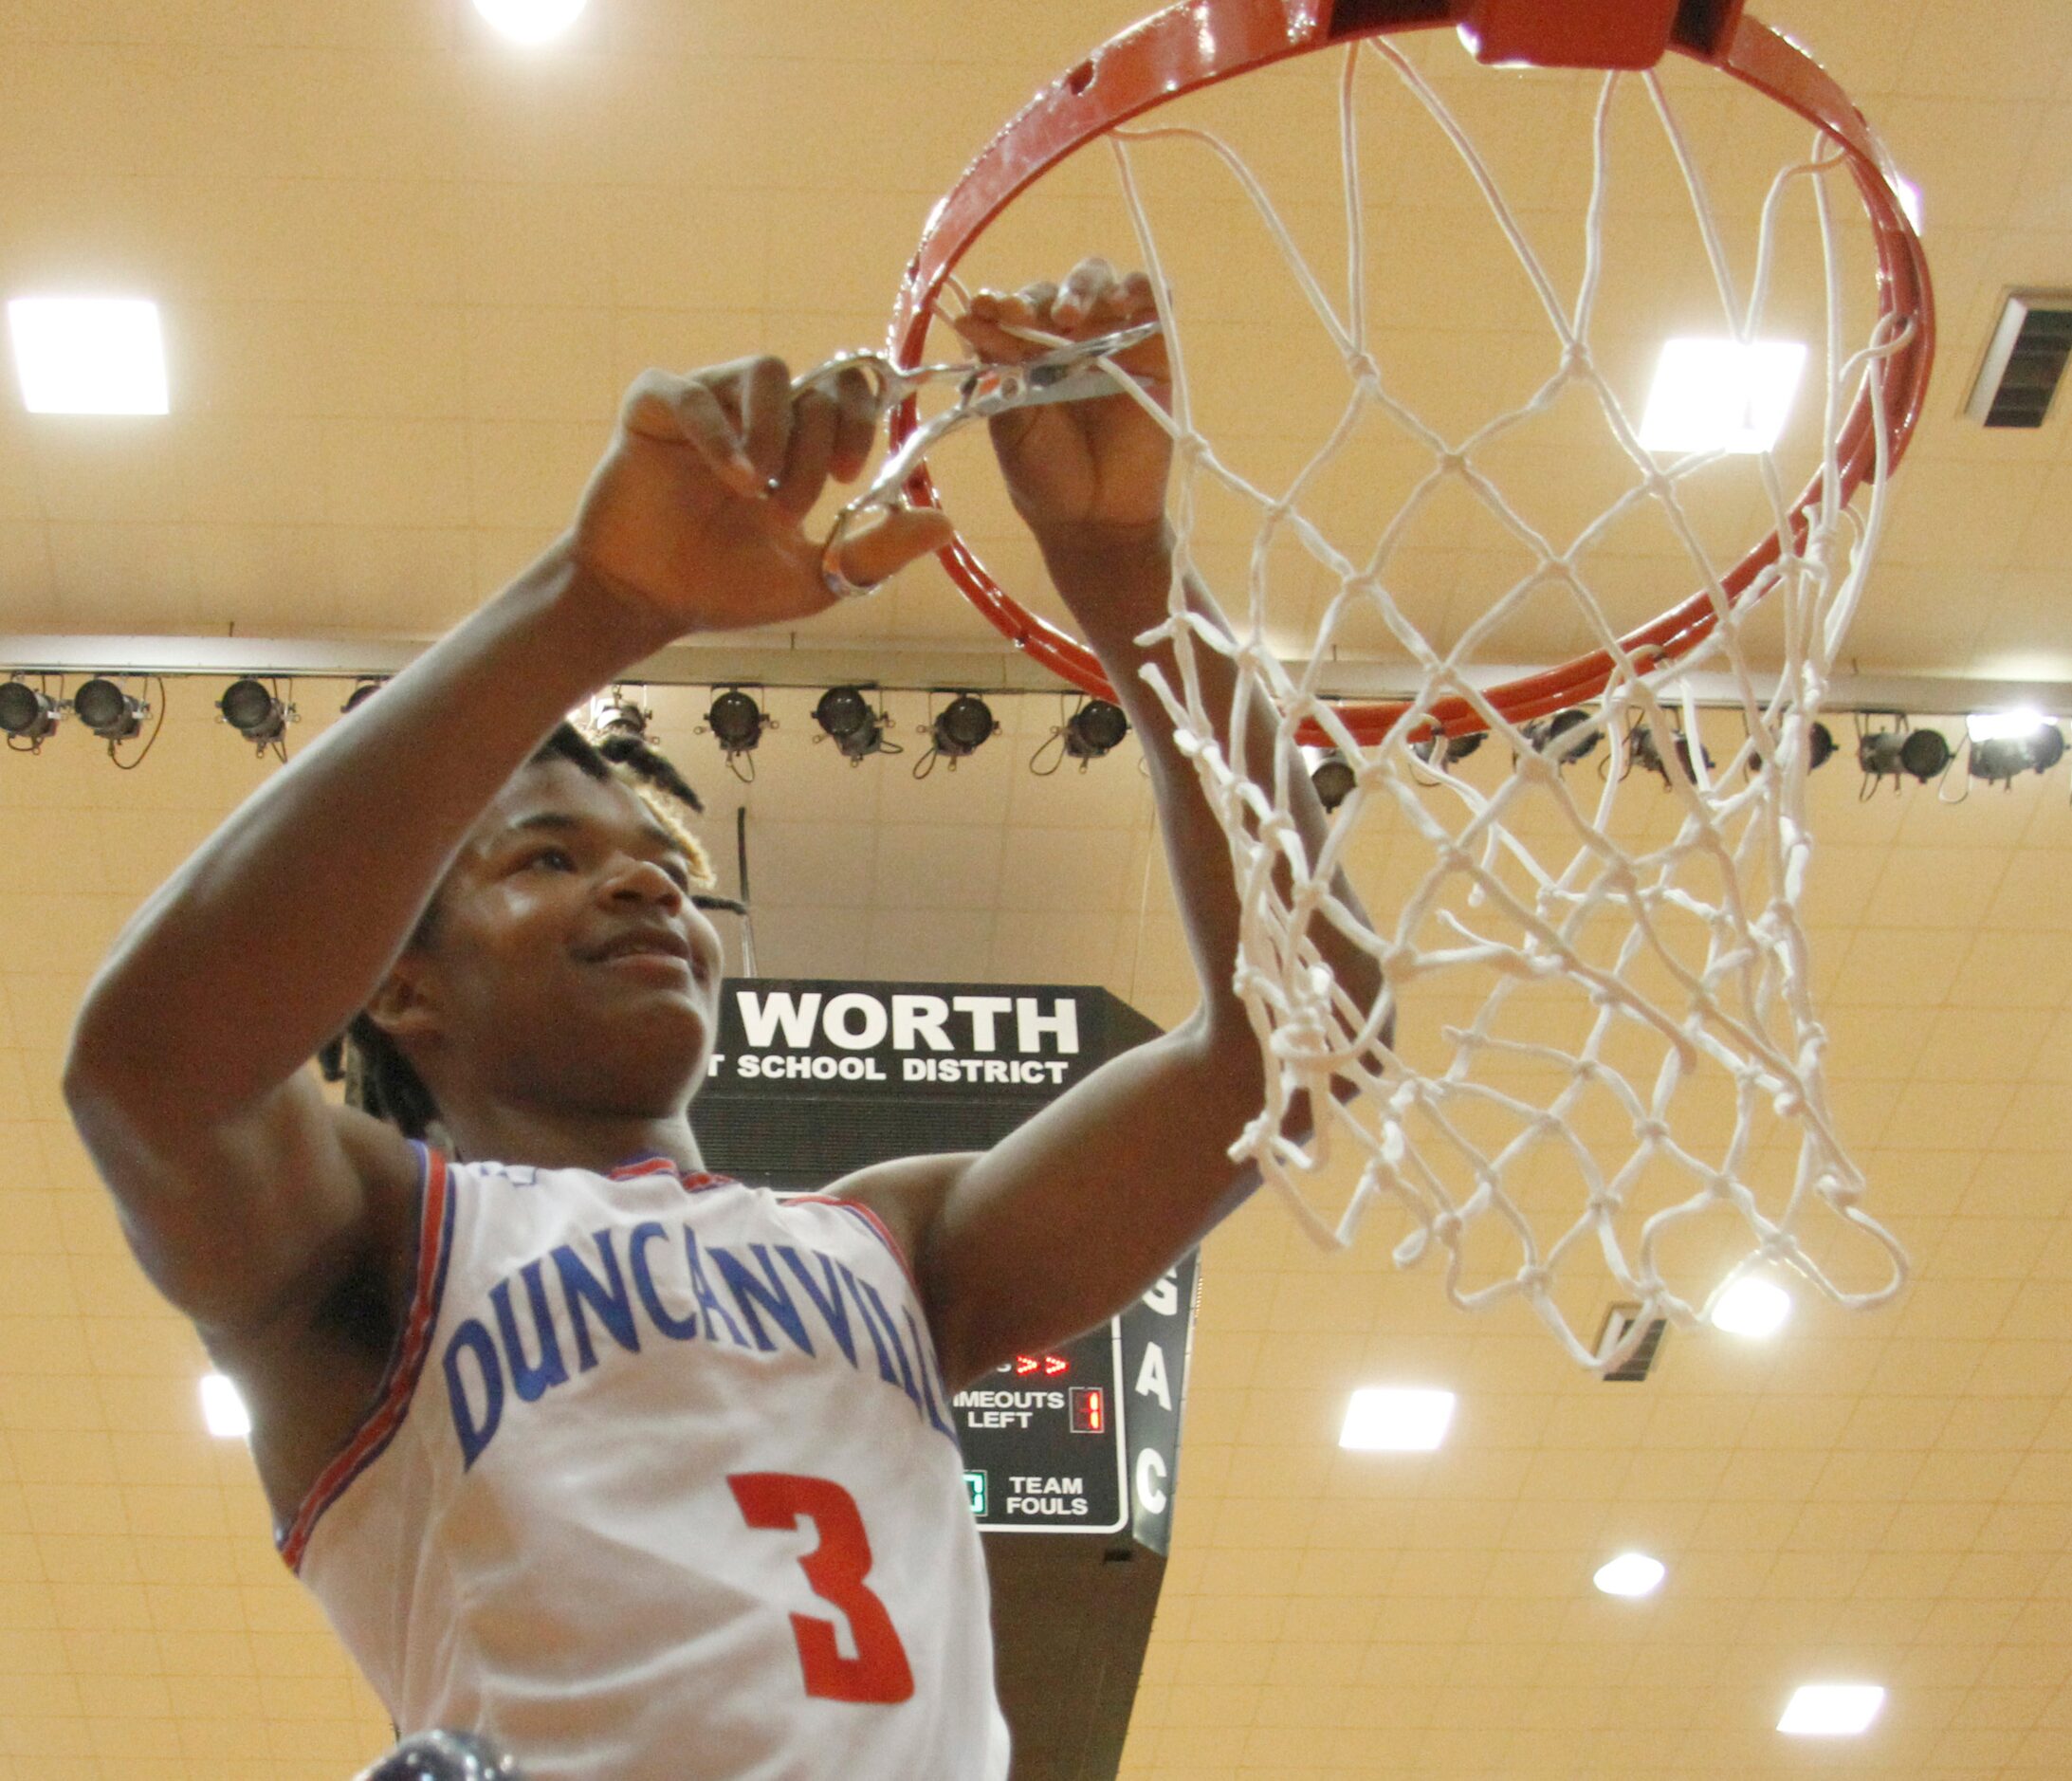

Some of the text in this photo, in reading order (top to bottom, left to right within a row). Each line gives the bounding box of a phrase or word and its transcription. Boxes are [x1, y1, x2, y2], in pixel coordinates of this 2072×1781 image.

[737, 992, 1079, 1054] WORTH
[737, 1055, 887, 1081] SCHOOL
[903, 1058, 1069, 1085] DISTRICT
[442, 1221, 962, 1474] DUNCANVILL
[967, 1411, 1033, 1428] LEFT
[1009, 1477, 1083, 1495] TEAM
[1006, 1497, 1089, 1515] FOULS
[726, 1471, 916, 1705] 3
